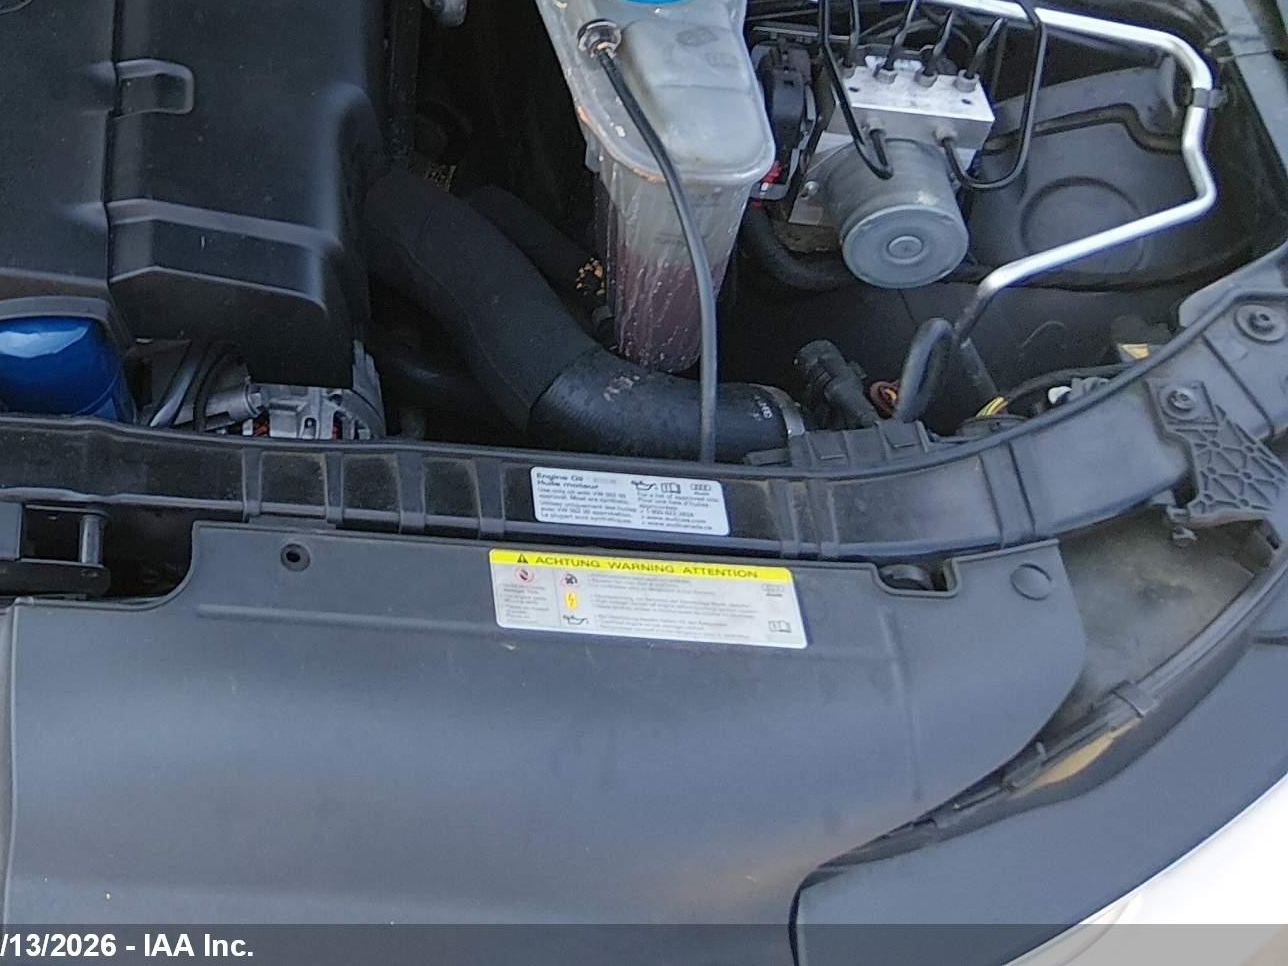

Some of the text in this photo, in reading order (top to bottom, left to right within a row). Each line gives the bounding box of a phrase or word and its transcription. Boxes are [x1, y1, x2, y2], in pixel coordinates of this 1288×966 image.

[536, 472, 569, 482] Engine
[571, 474, 584, 482] Oil
[535, 556, 759, 579] ACHTUNG WARNING ATTENTION
